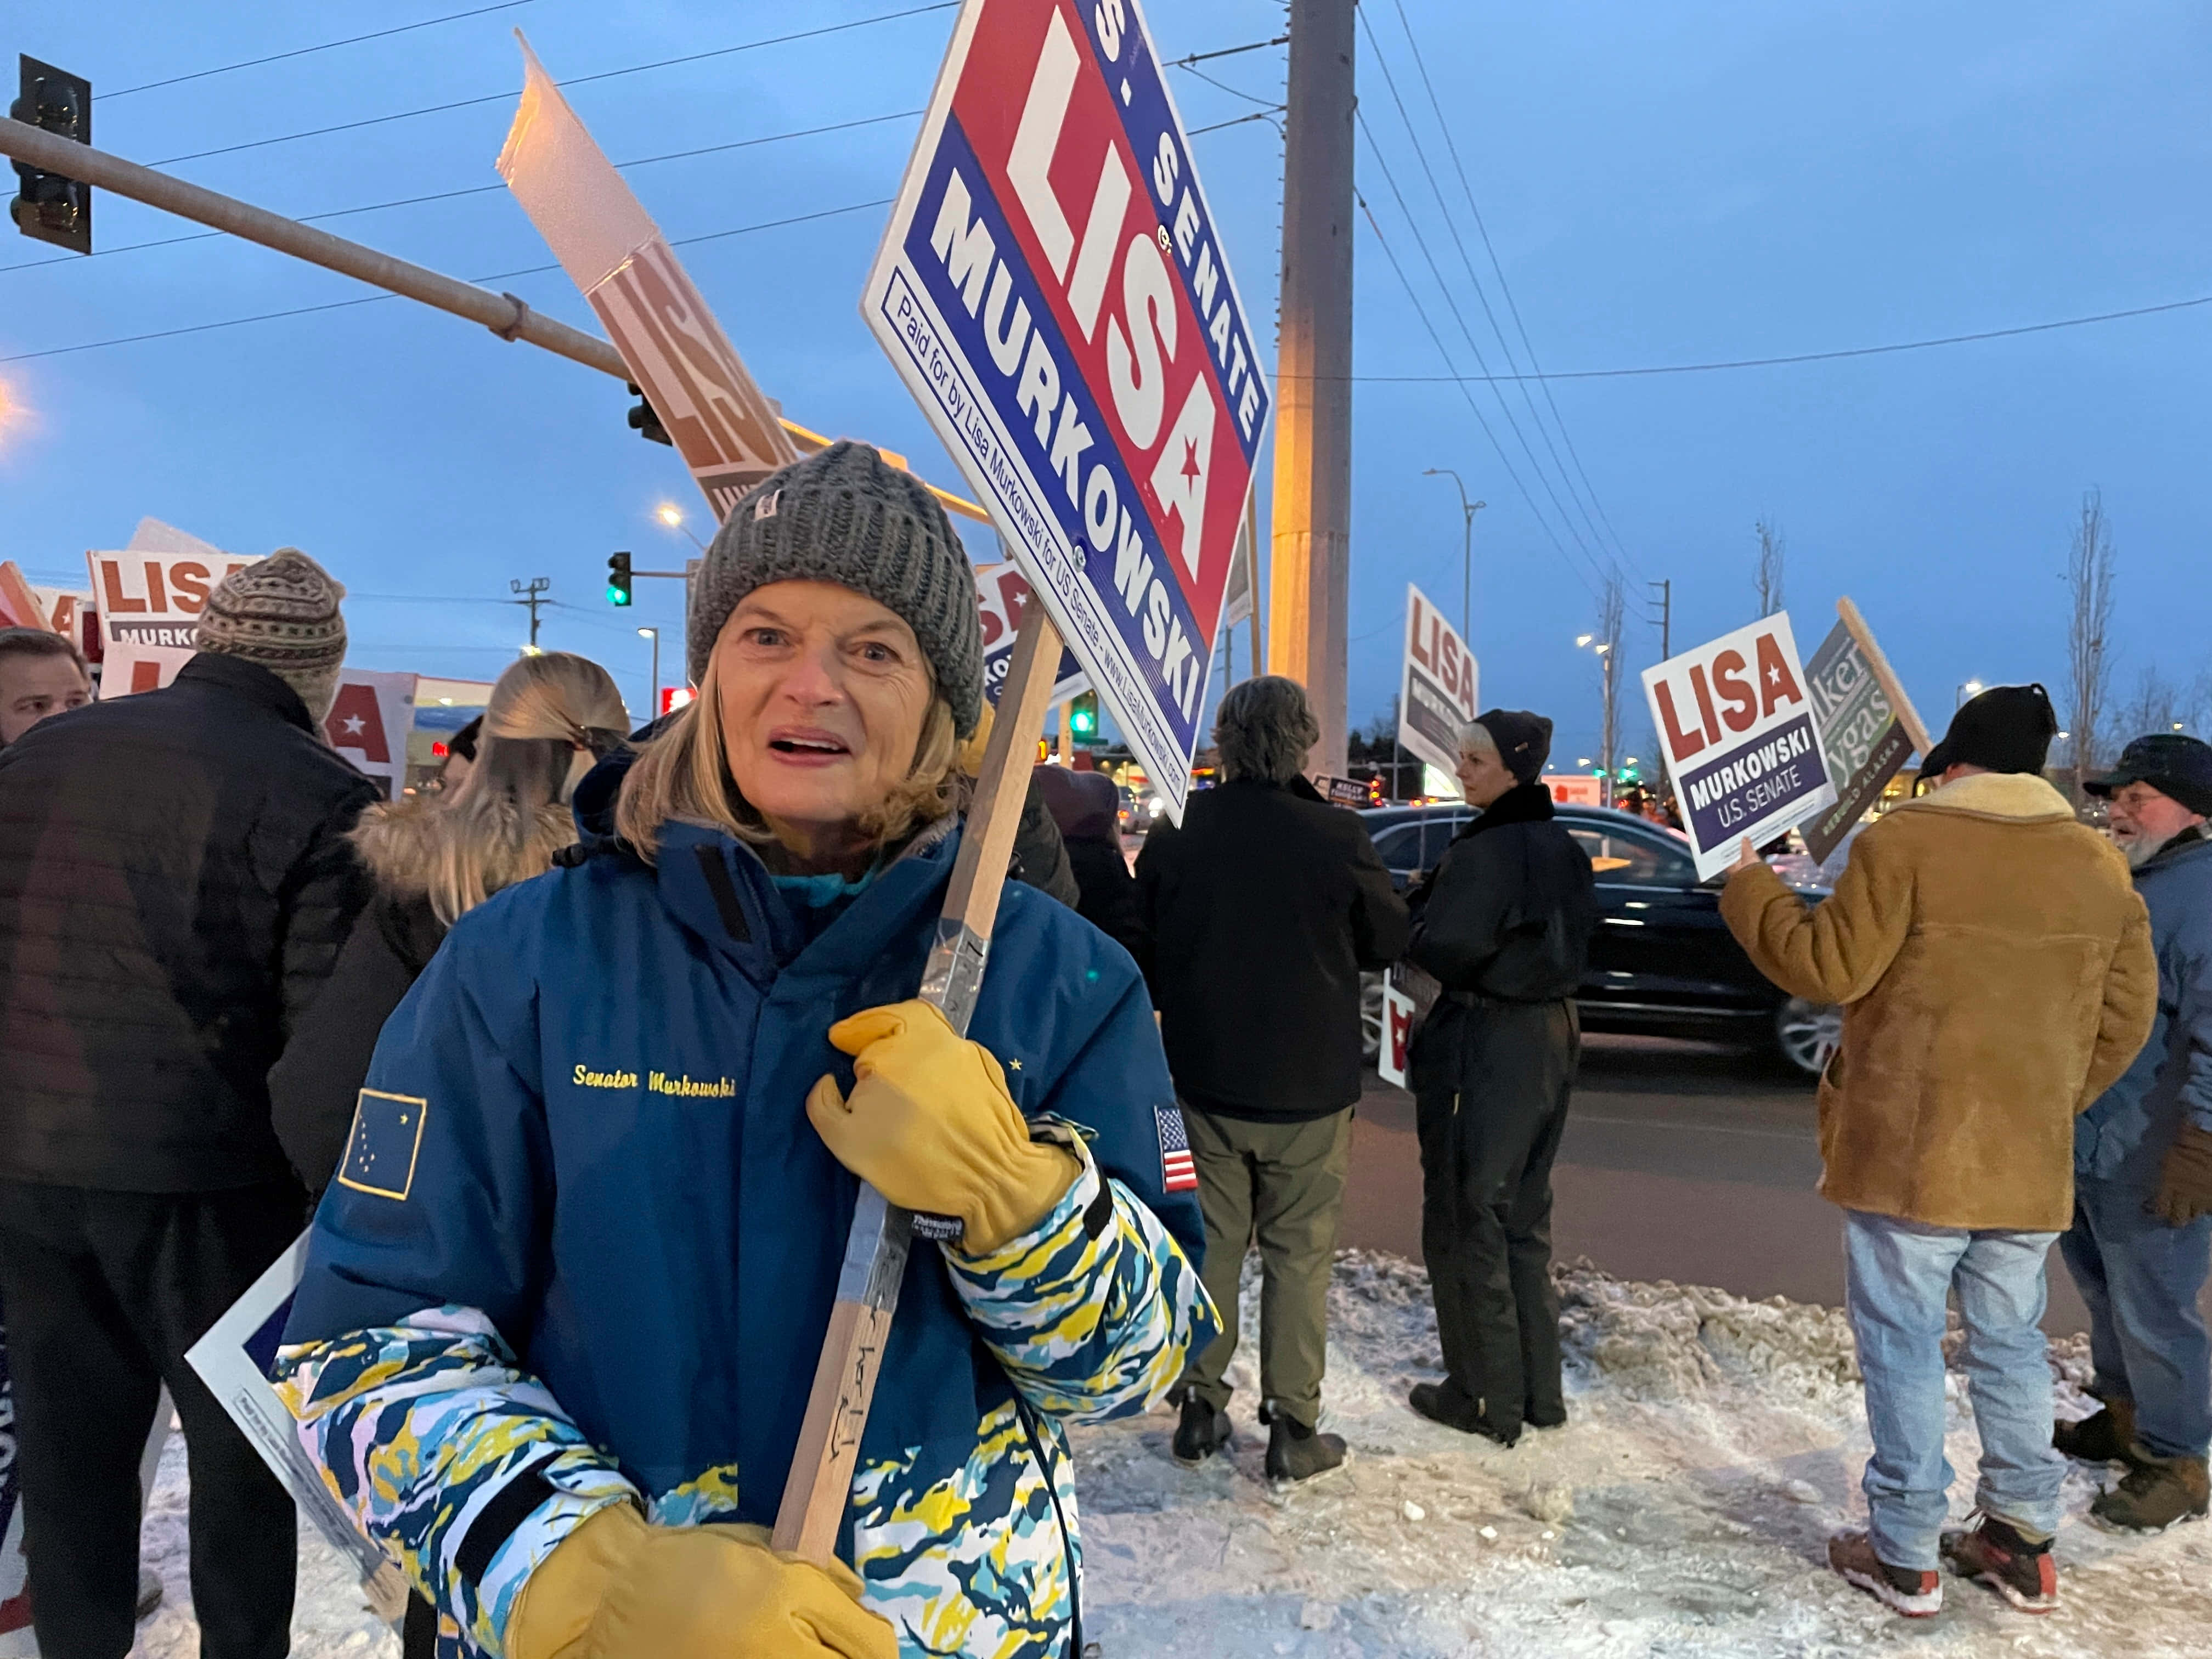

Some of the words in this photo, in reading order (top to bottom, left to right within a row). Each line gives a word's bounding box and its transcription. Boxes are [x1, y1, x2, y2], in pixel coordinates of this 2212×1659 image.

[1006, 4, 1216, 584] LISA
[1153, 132, 1261, 442] SENATE
[898, 295, 930, 358] Paid
[929, 348, 948, 387] for
[948, 378, 965, 419] by
[964, 406, 989, 460] Lisa
[990, 448, 1043, 546] Murkowski
[1042, 538, 1057, 570] for
[1056, 561, 1071, 597] US
[1070, 588, 1099, 647] Senate
[930, 167, 1200, 725] MURKOWSKI
[101, 561, 246, 613] LIS
[1410, 596, 1475, 719] LISA
[1654, 633, 1803, 763] LISA
[1689, 726, 1811, 811] MURKOWSKI
[1717, 798, 1747, 828] U.S.
[1746, 765, 1802, 812] SENATE
[1827, 689, 1891, 789] ygas
[573, 1064, 637, 1088] Senator
[648, 1070, 736, 1098] Murkowski
